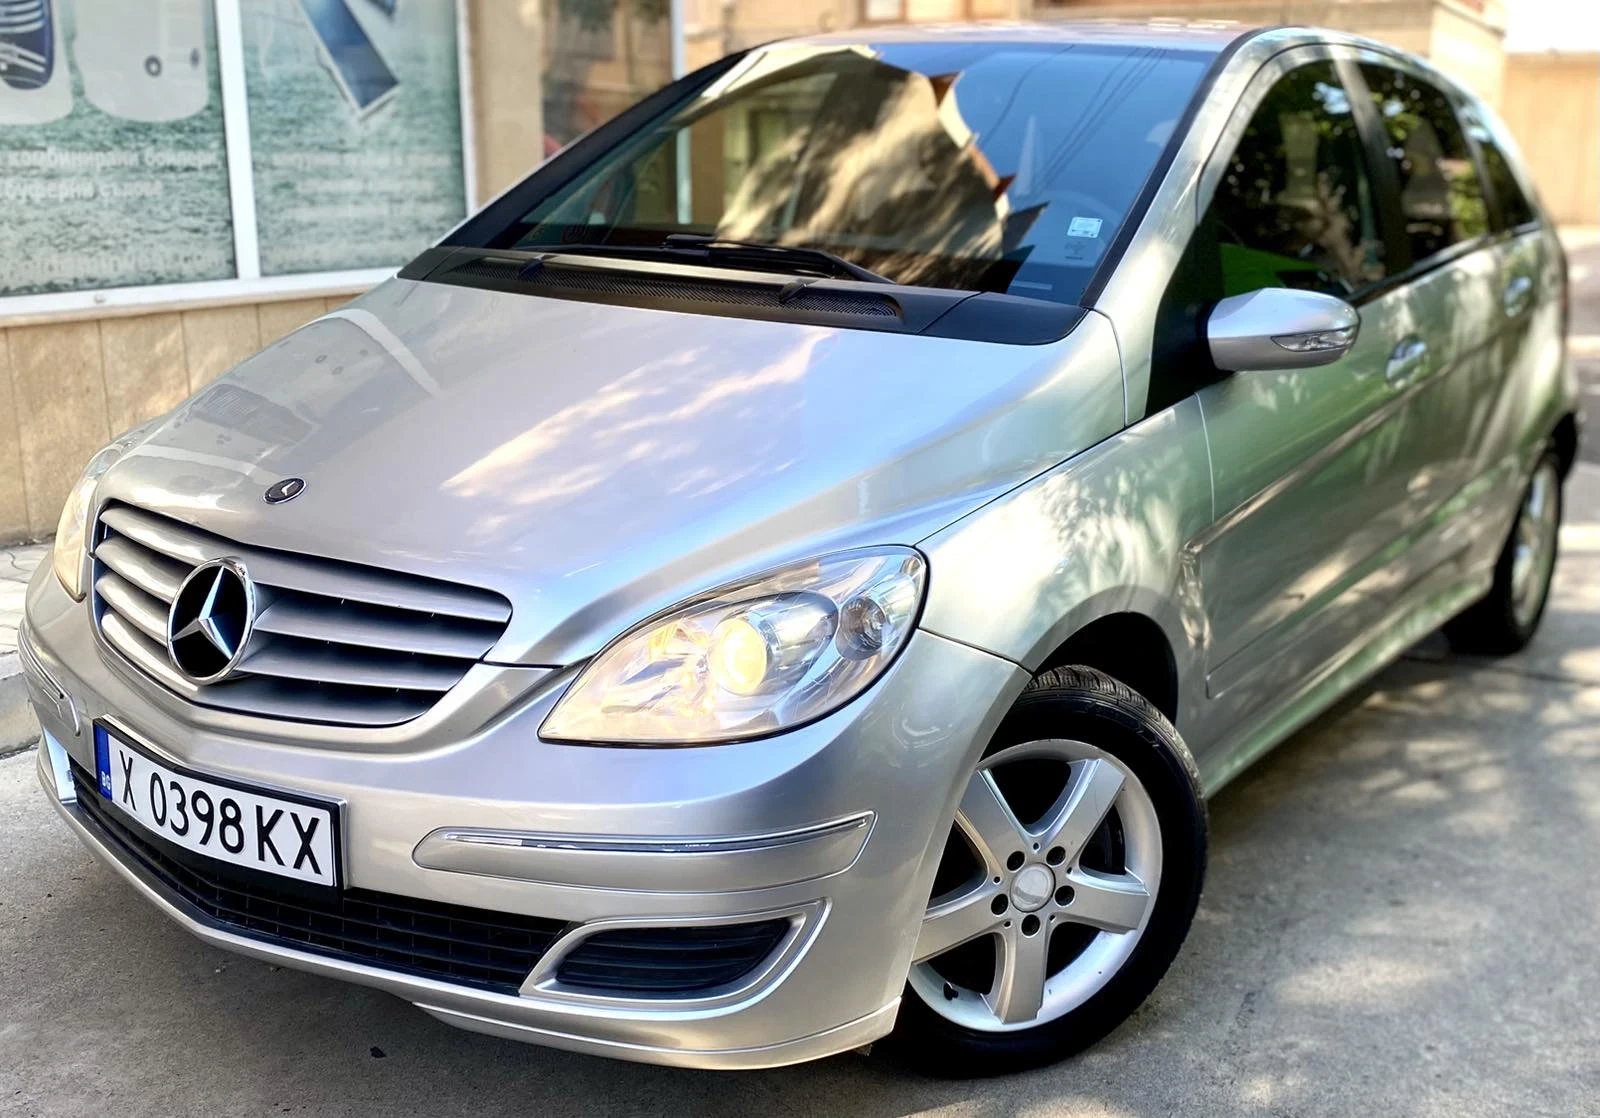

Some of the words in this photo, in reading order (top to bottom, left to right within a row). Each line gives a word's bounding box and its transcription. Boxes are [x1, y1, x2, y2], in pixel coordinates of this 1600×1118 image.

[101, 770, 111, 790] BG
[119, 749, 137, 812] X
[150, 772, 245, 854] 0398
[255, 804, 322, 876] KX
